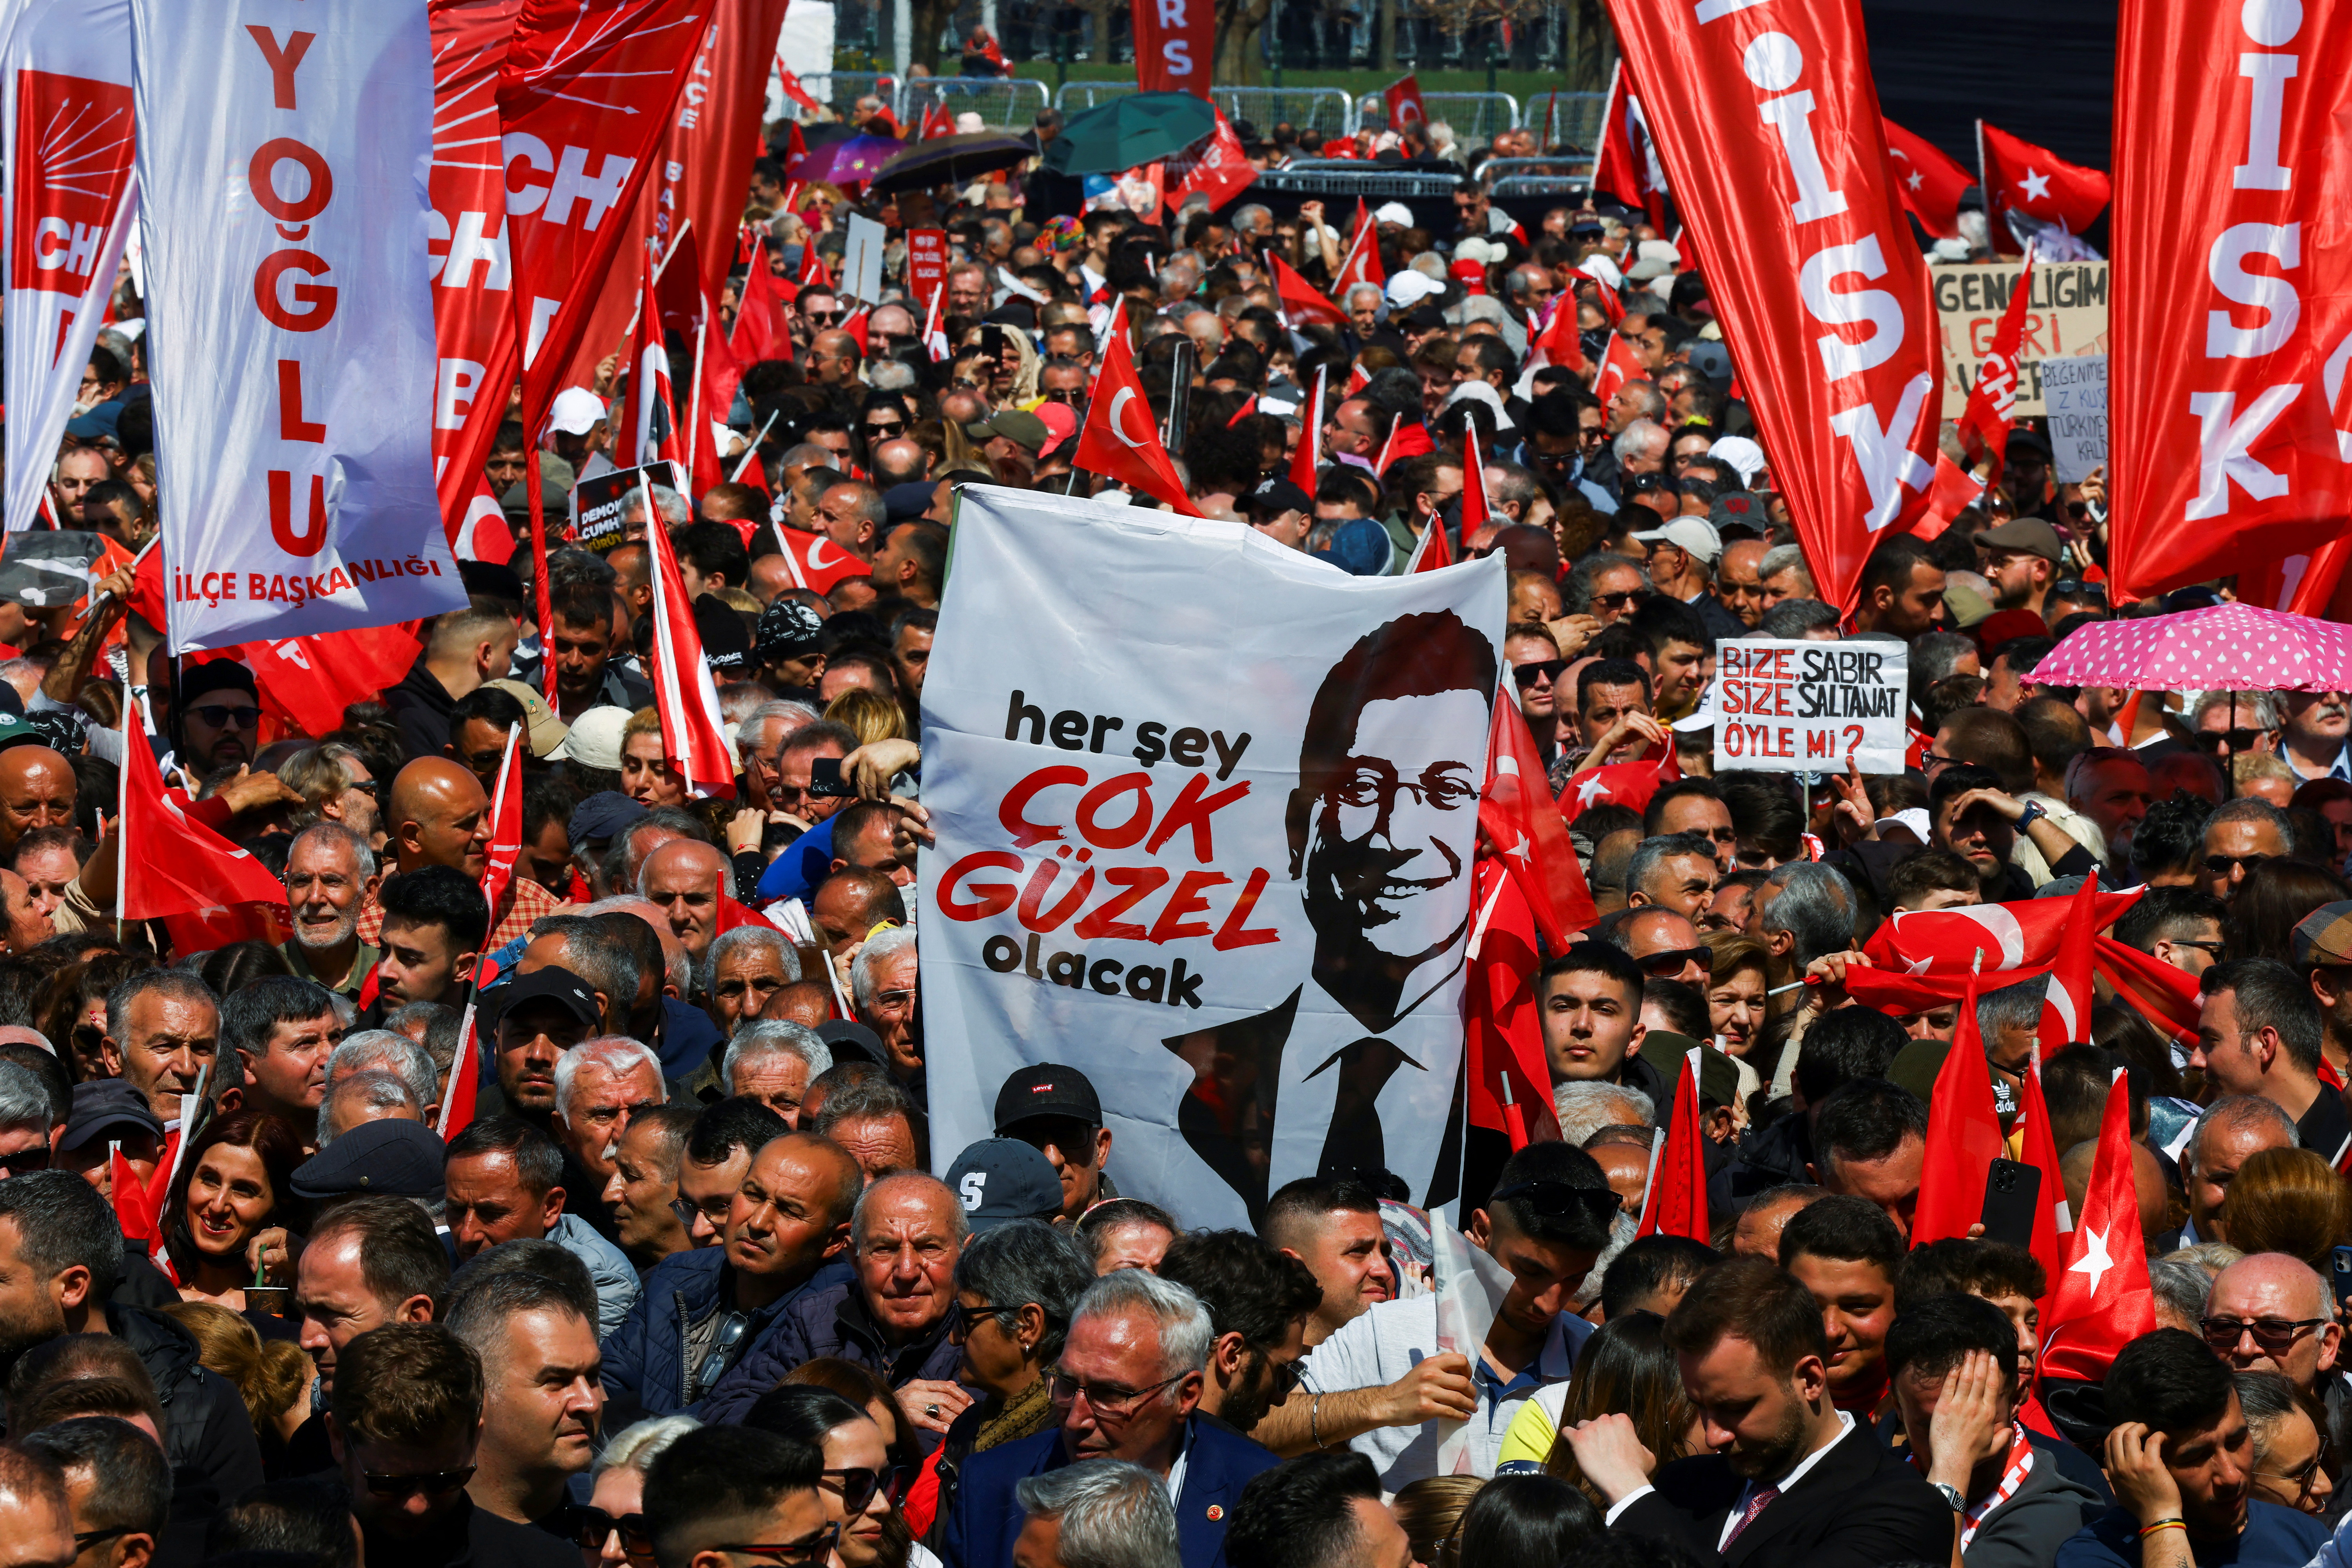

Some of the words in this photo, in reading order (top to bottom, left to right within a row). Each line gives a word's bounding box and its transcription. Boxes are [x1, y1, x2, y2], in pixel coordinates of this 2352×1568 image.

[677, 24, 719, 129] İLÇE
[34, 217, 105, 276] CH
[246, 0, 338, 557] YOĞLU
[1935, 265, 2107, 312] GENLİĞİM
[1969, 313, 2062, 358] GRİ
[2042, 361, 2108, 387] BEĞENME
[2058, 391, 2070, 409] Z
[582, 516, 620, 541] CUMH
[175, 566, 236, 608] İLÇE
[249, 554, 441, 608] BAŞKANLIĞI
[1802, 649, 1885, 684] SABIR
[1722, 679, 1794, 717] SİZE
[1797, 682, 1900, 719] SALTANAT
[1005, 690, 1123, 753] her
[1132, 722, 1251, 781] şey
[1724, 716, 1795, 758] ÖYLE
[999, 765, 1252, 864] ÇOK
[936, 844, 1281, 951] GÜZEL
[576, 988, 586, 997] NIKE
[983, 933, 1203, 1009] olacak
[960, 1172, 987, 1210] S
